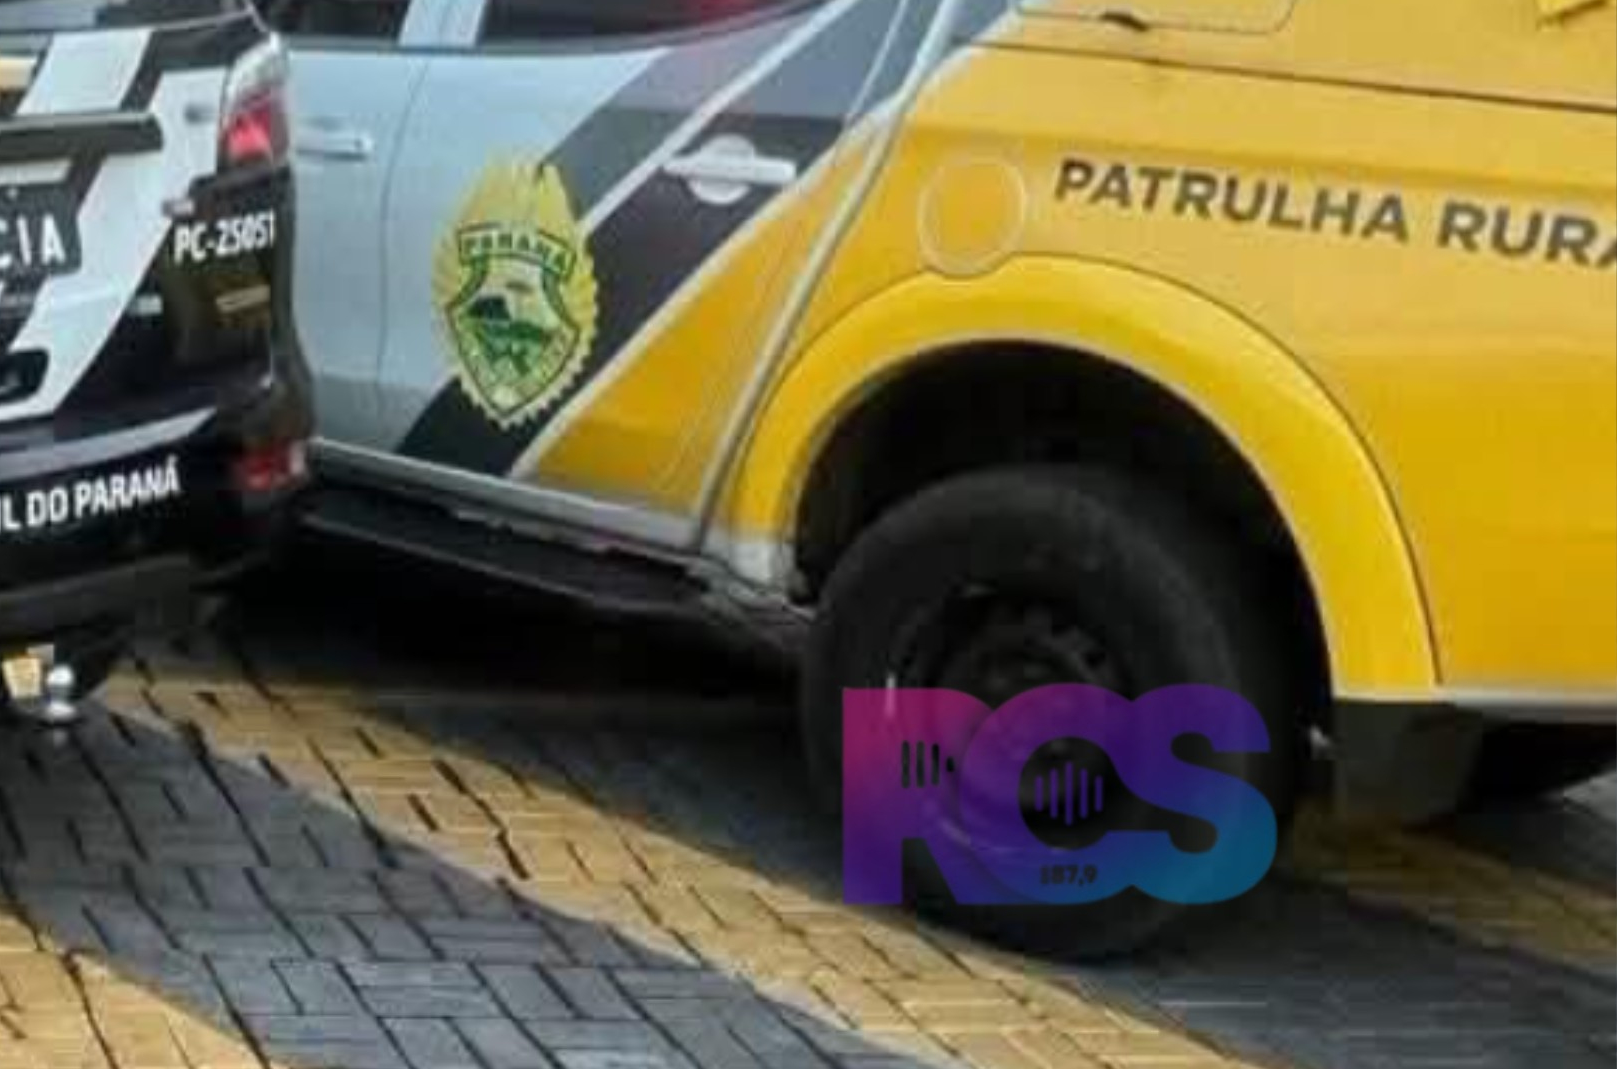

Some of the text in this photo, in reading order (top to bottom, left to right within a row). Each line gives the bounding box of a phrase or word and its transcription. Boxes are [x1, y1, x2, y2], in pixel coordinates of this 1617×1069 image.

[1053, 158, 1410, 244] PATRULHA
[26, 485, 69, 528] DO
[73, 455, 181, 519] PARANÁ
